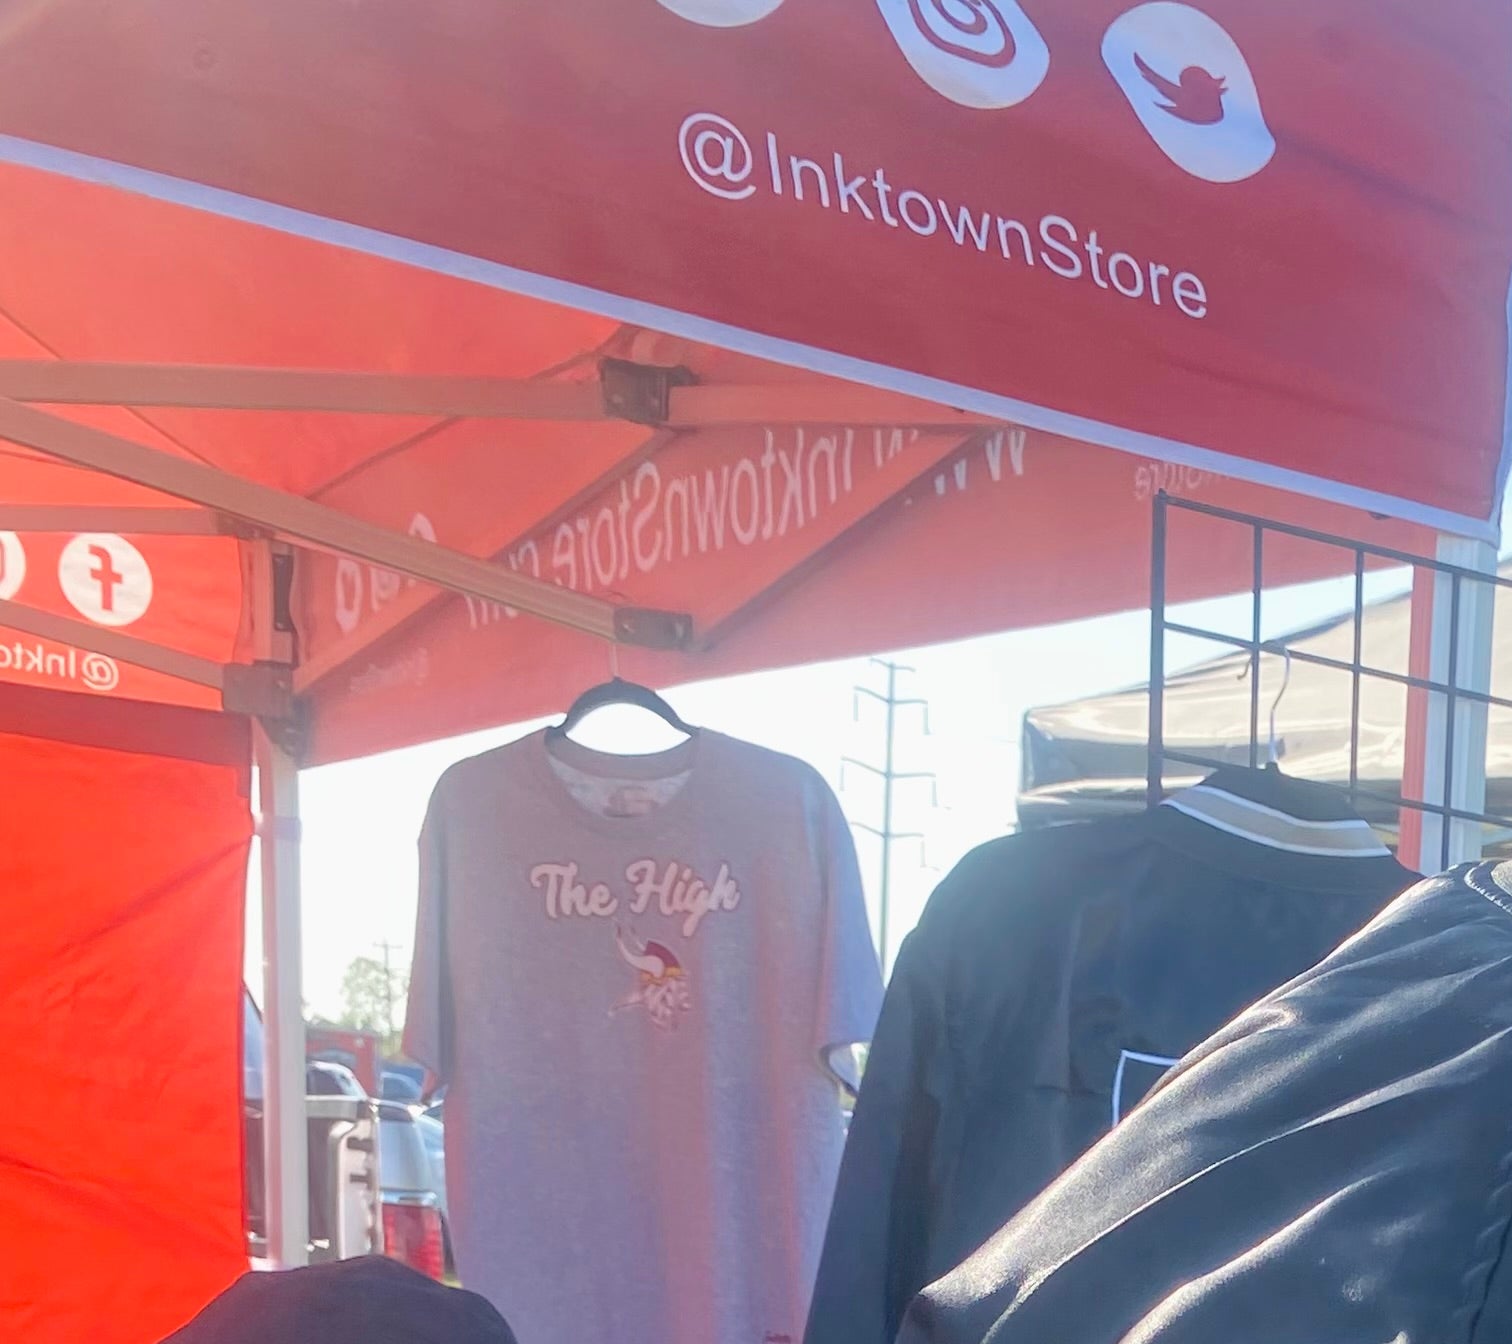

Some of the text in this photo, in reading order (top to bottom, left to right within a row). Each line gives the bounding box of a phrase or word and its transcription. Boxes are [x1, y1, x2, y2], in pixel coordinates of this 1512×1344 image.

[678, 112, 1208, 319] @InktownStore
[529, 858, 742, 938] The High
